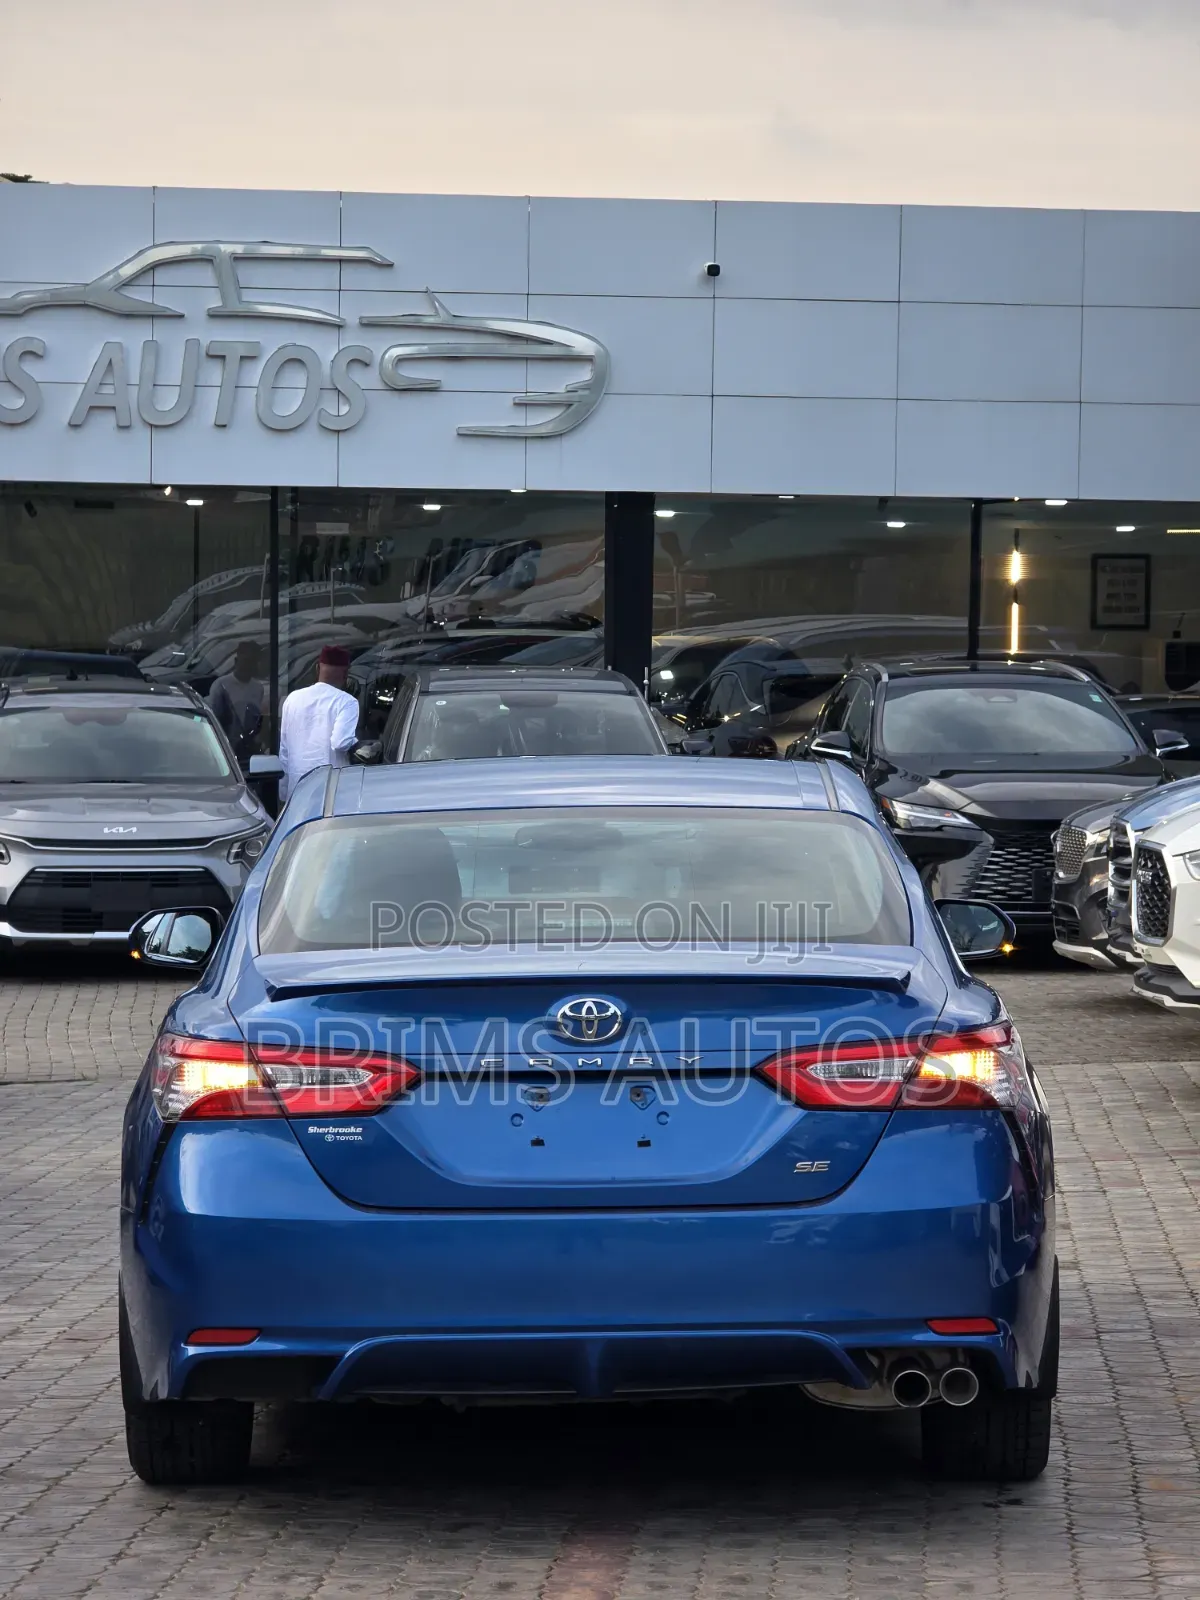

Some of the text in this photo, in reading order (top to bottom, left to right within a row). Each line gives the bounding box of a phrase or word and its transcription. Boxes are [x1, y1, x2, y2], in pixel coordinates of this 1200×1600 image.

[68, 337, 371, 432] AUTOS
[103, 826, 138, 834] KIA
[480, 1055, 705, 1068] CAMRY
[307, 1126, 363, 1134] Sherbrooke
[793, 1160, 831, 1173] SE
